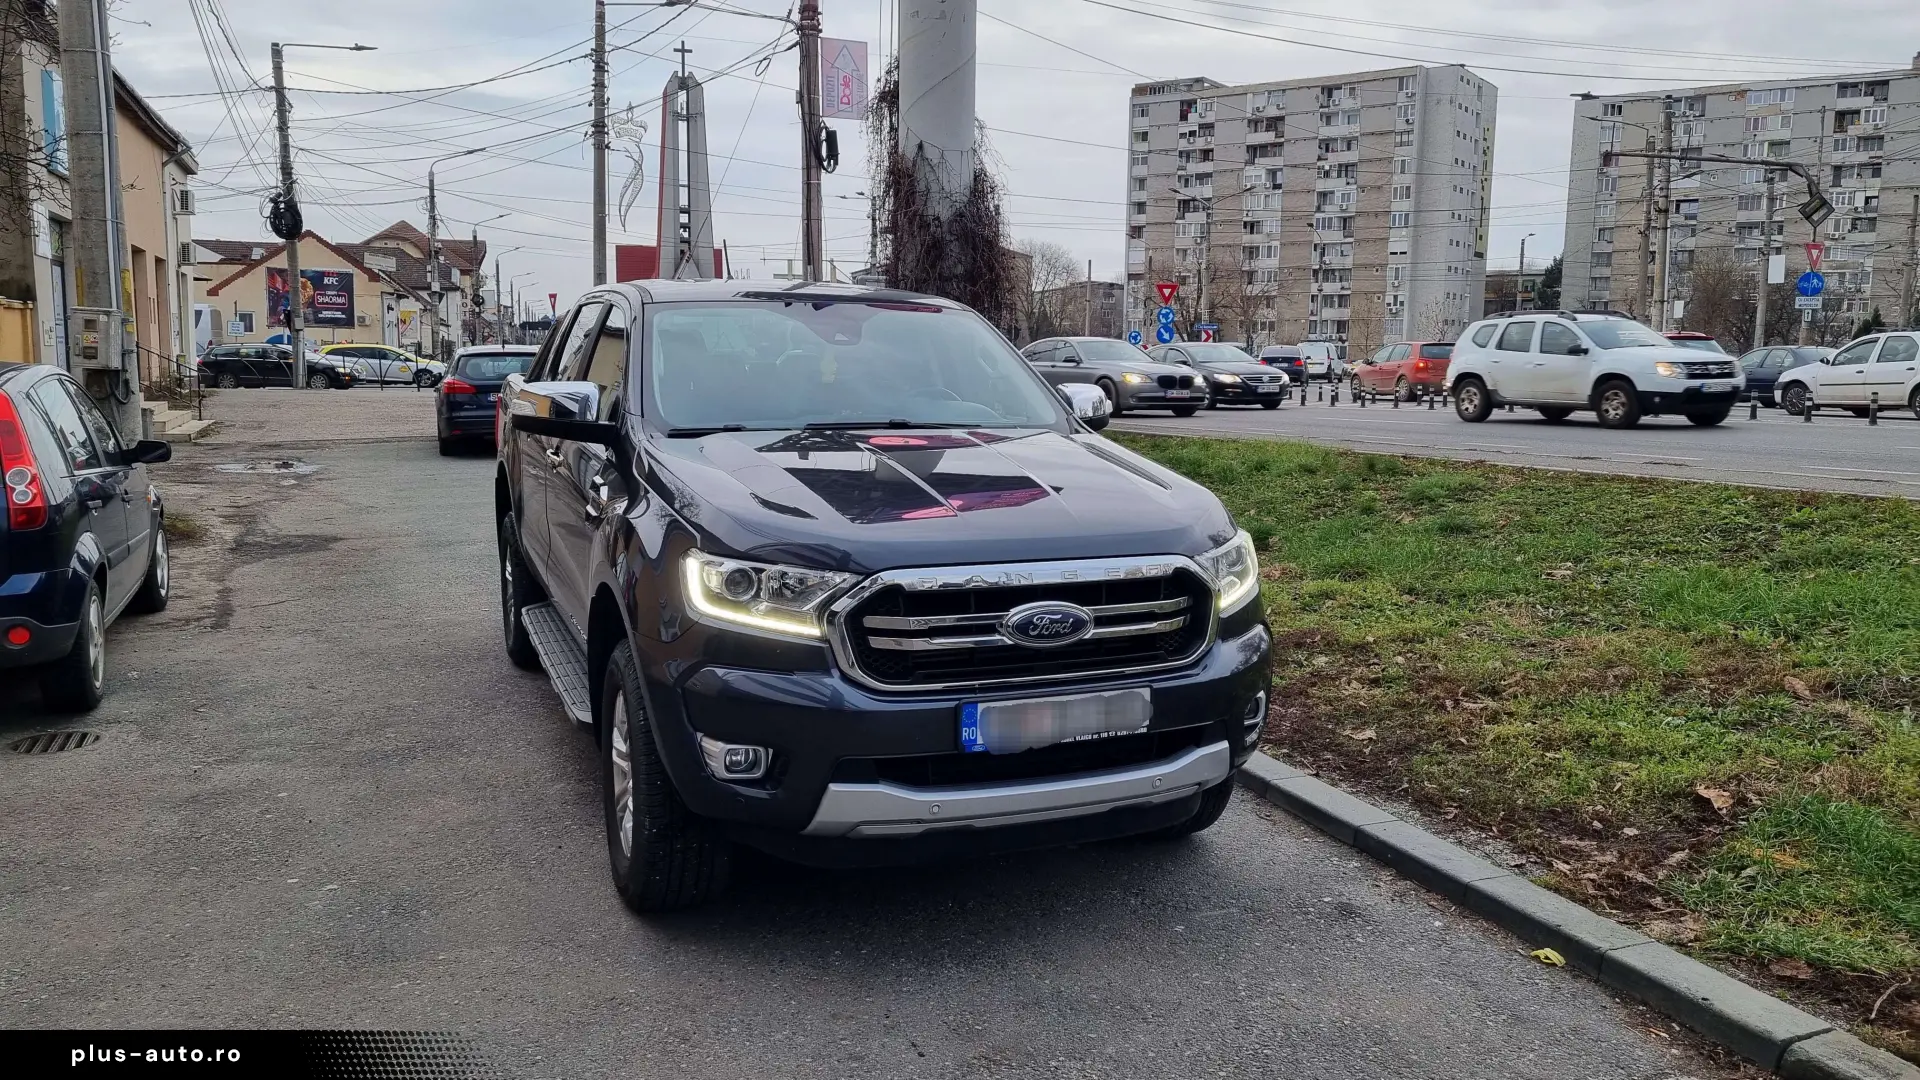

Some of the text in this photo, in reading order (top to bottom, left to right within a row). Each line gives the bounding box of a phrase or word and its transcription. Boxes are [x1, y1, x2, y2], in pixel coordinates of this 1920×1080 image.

[825, 74, 836, 108] DEPOZIT
[839, 74, 852, 106] Dole
[323, 276, 339, 285] KFC
[317, 295, 346, 304] SHAORMA
[918, 564, 1161, 589] RANGER
[1028, 613, 1073, 637] Ford
[962, 726, 976, 741] RO
